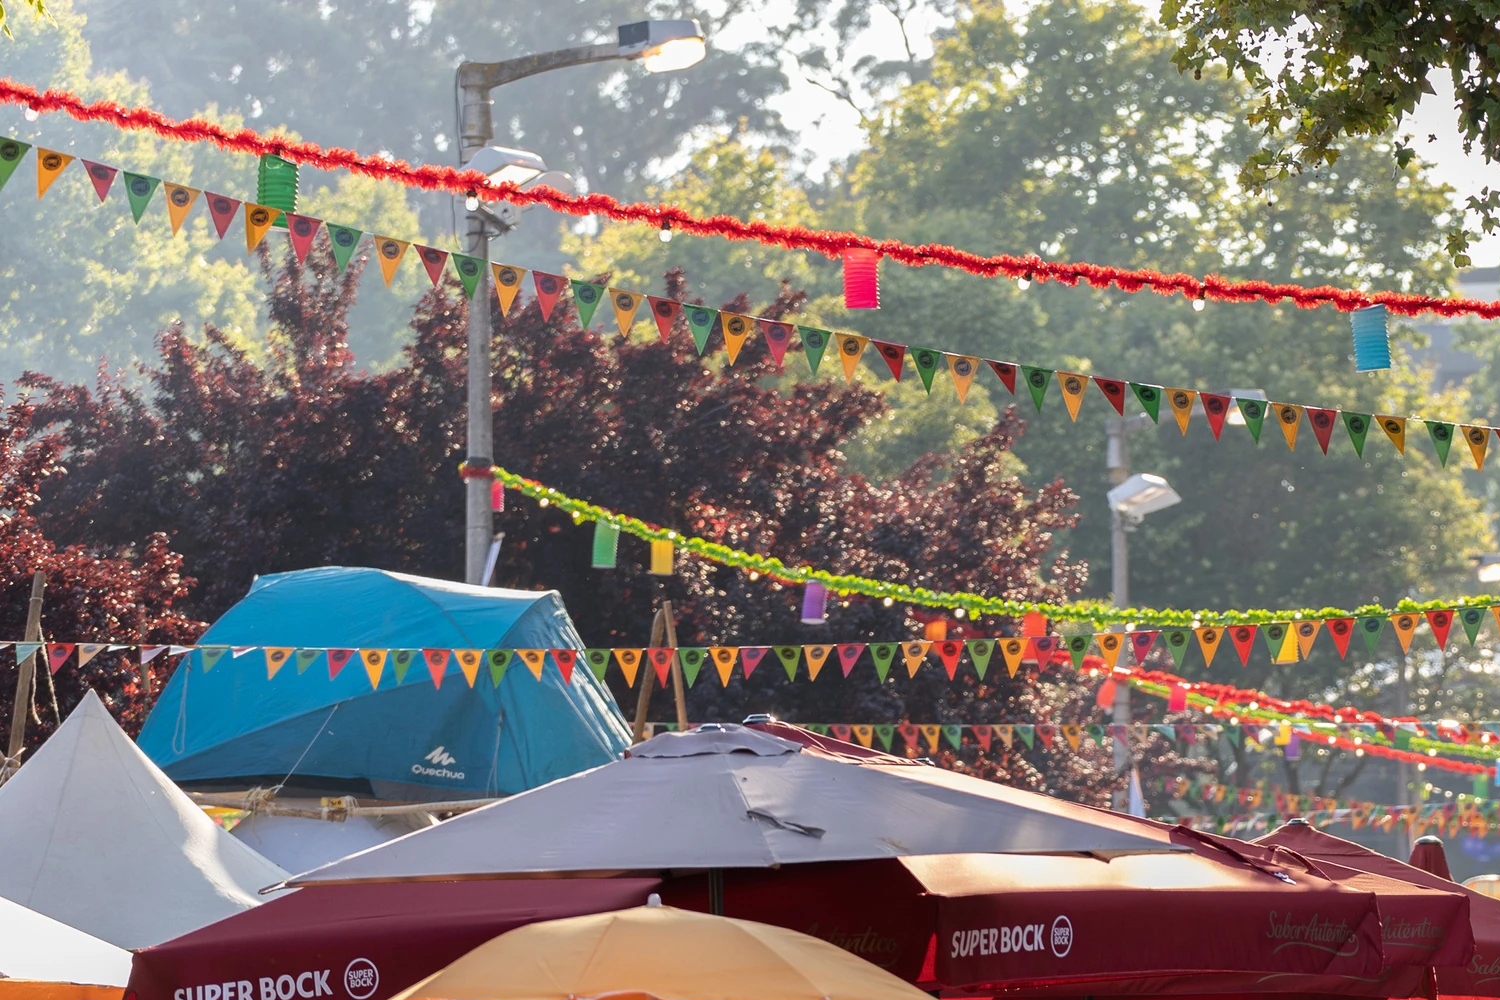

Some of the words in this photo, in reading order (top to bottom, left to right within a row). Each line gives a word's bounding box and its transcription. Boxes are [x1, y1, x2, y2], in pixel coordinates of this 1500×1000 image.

[411, 764, 465, 780] Quechua
[1266, 910, 1305, 939] Sabor
[1053, 927, 1070, 937] SUPER
[951, 927, 999, 959] SUPER
[1000, 923, 1045, 953] BOCK
[1054, 936, 1069, 945] BOCK
[348, 968, 374, 980] SUPER
[350, 977, 373, 989] BOCK
